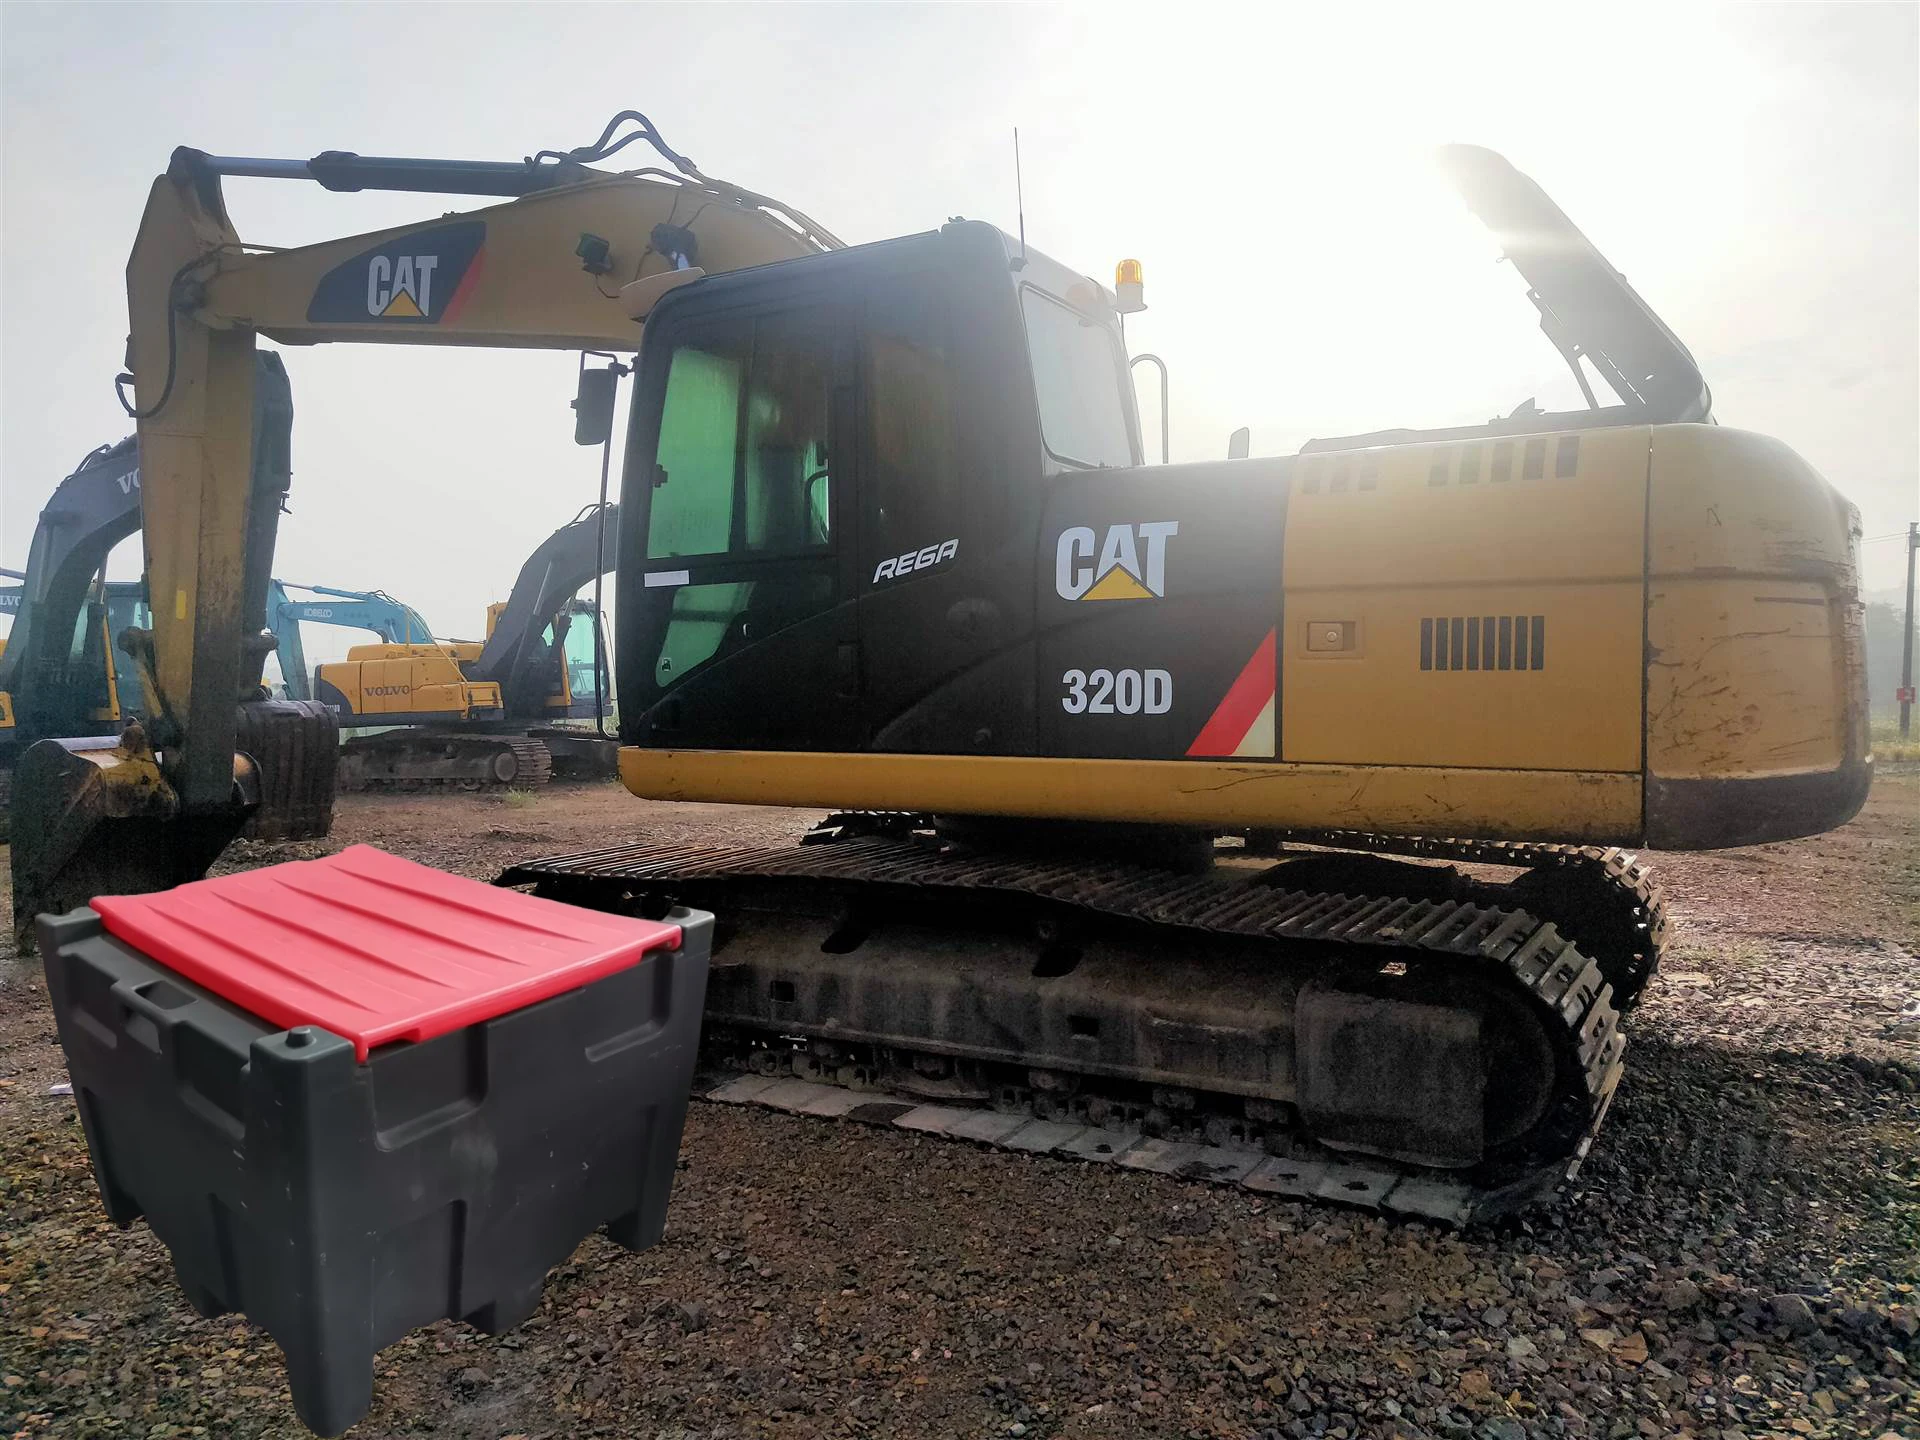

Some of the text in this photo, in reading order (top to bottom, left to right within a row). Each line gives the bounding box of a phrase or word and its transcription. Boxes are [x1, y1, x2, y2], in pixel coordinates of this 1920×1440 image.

[367, 255, 438, 317] CAT
[872, 538, 960, 584] REGA
[1055, 520, 1179, 601] CAT
[364, 685, 410, 697] VOLVO
[1061, 668, 1173, 715] 320D
